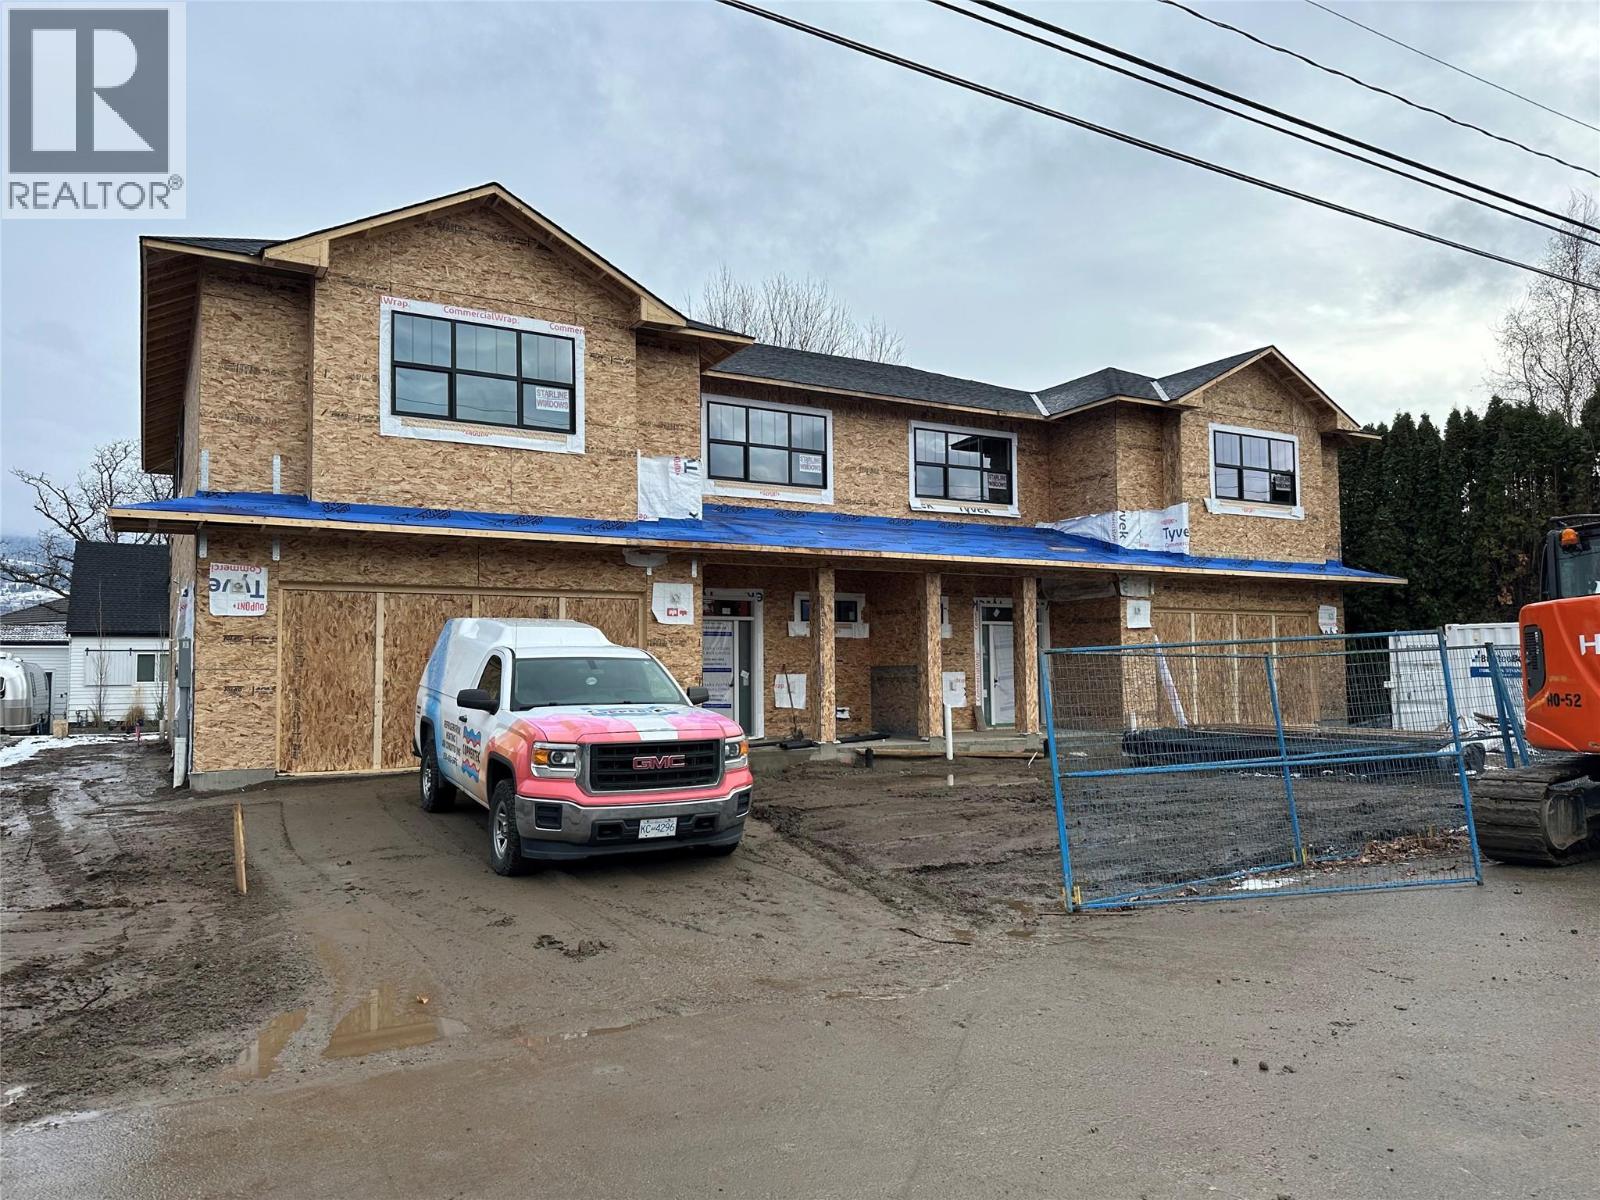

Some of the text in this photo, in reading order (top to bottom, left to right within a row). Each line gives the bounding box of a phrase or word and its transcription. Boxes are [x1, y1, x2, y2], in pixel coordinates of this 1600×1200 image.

[537, 399, 569, 409] WINDOWS
[237, 602, 265, 612] DUPONT
[633, 755, 685, 769] GMC
